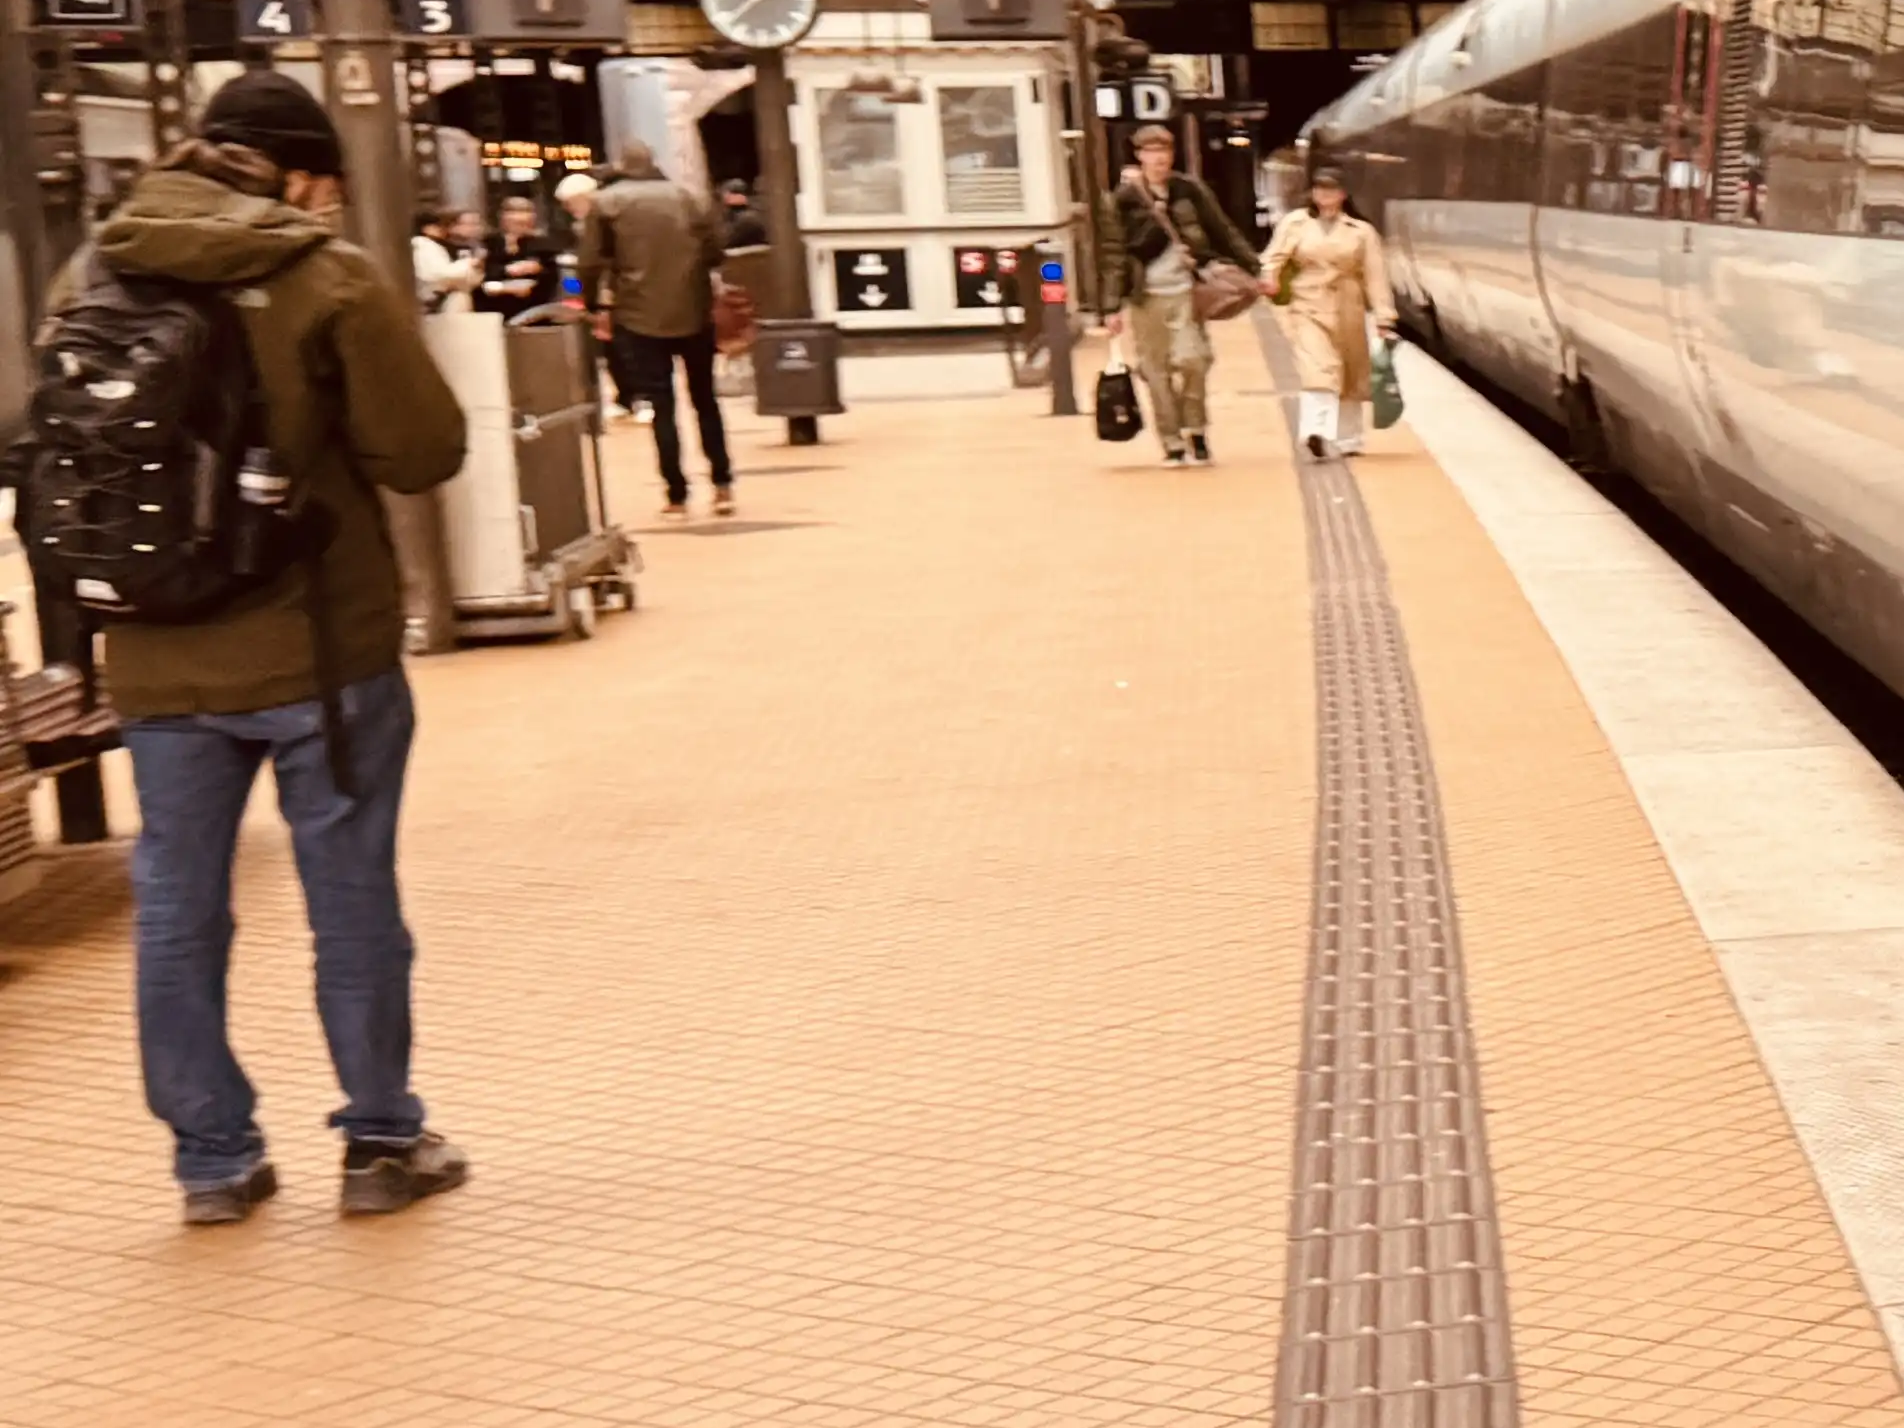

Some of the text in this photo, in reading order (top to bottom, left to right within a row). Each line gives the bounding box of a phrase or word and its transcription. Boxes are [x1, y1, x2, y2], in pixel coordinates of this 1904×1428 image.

[257, 1, 292, 34] 4
[418, 0, 452, 33] 3
[1132, 83, 1171, 120] D
